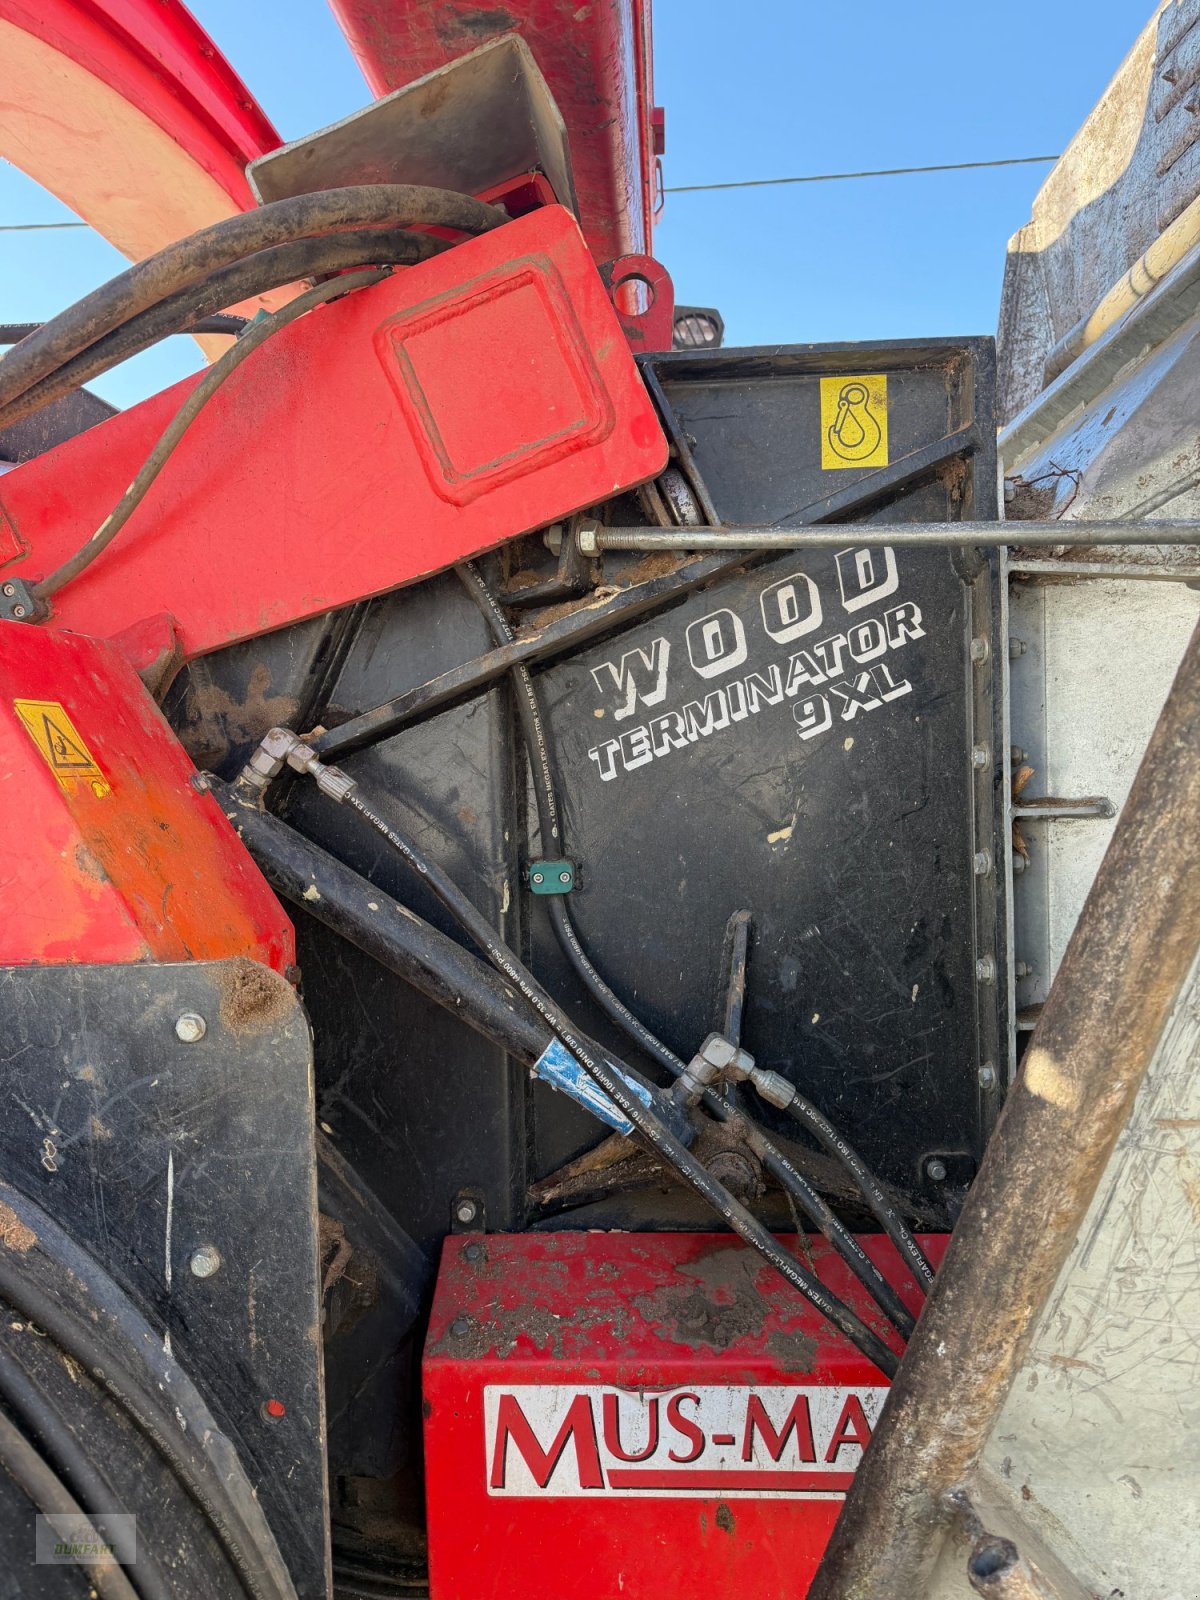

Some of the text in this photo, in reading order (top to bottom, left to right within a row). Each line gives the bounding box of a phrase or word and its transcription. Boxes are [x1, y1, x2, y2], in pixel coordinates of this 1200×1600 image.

[590, 547, 899, 720] WOOD
[520, 665, 529, 681] 2SC
[588, 601, 926, 782] TERMINATOR
[529, 698, 536, 709] EN
[546, 791, 556, 815] GATES
[387, 831, 410, 854] GATES
[503, 962, 520, 982] (4800
[518, 980, 533, 997] MPa
[530, 995, 546, 1013] 33.0
[544, 1011, 557, 1025] WP
[575, 1047, 594, 1067] DN10
[591, 1065, 616, 1093] 100R16
[613, 1091, 630, 1108] SAE
[792, 1096, 807, 1110] R16
[835, 1141, 850, 1155] ISO
[806, 1287, 833, 1313] GATES
[490, 1393, 874, 1489] MUS-MA
